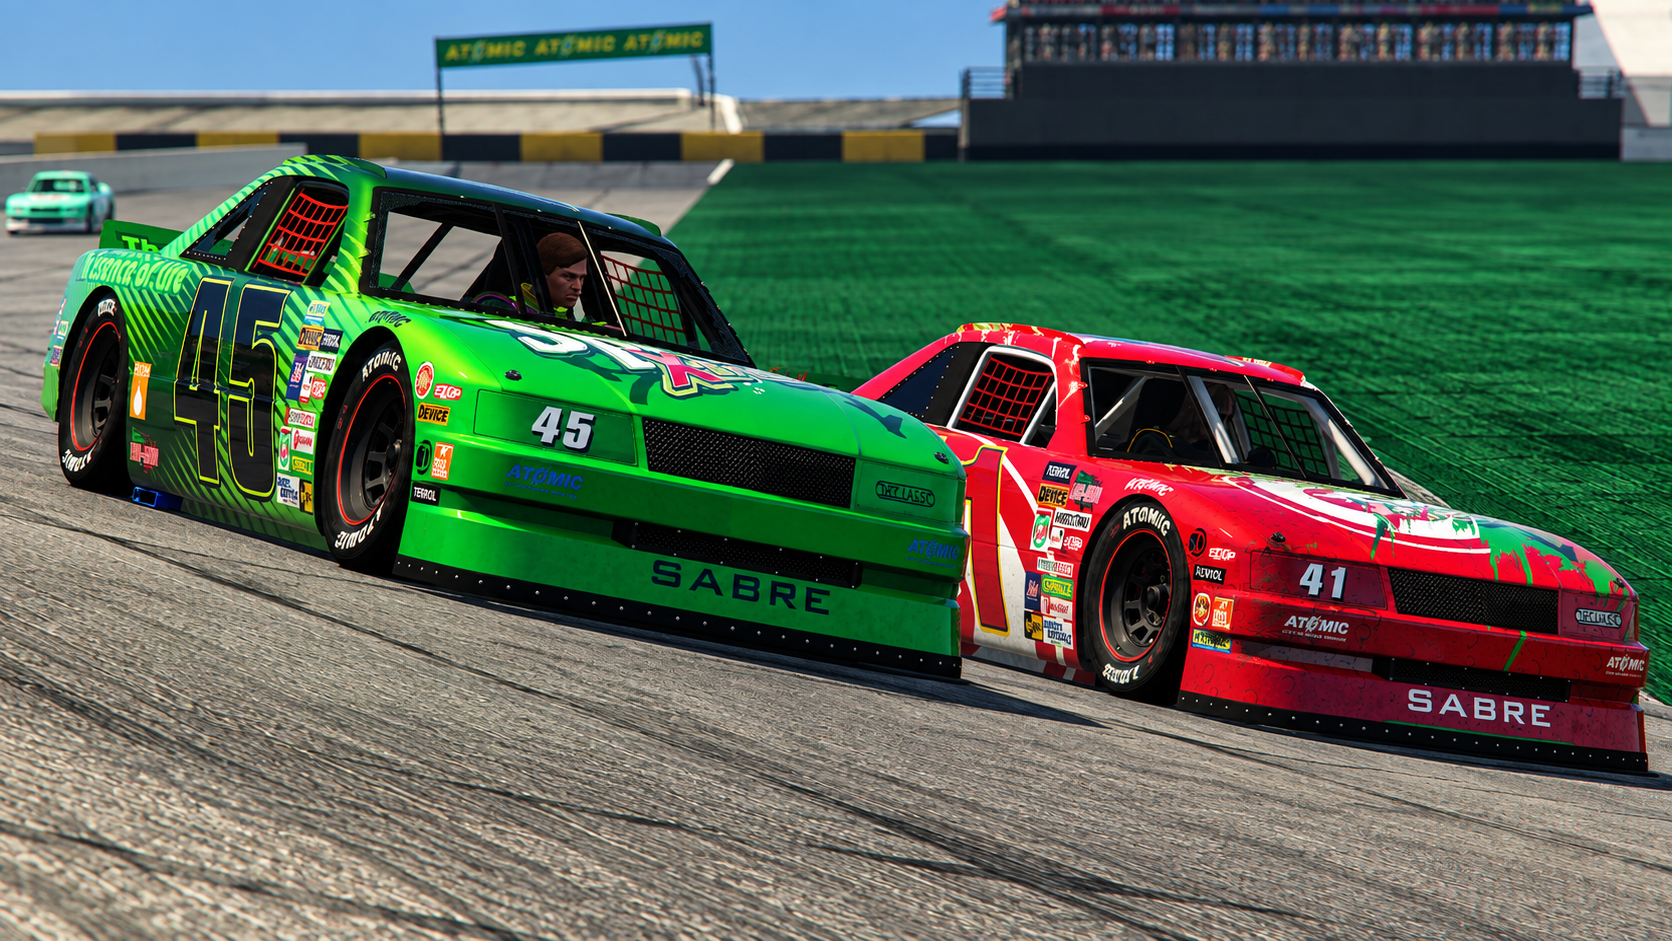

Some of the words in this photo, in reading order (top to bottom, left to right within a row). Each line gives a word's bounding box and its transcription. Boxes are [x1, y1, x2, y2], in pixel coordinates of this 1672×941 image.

[445, 40, 527, 63] ATOMIC
[534, 34, 616, 58] ATOMIC
[623, 30, 704, 54] ATOMIC
[361, 351, 402, 382] ATOMIC
[174, 276, 292, 500] 45
[417, 404, 449, 423] DEVICE
[531, 405, 596, 452] 45
[507, 464, 583, 490] ATOMIC
[906, 538, 960, 560] ATOMIC
[651, 559, 831, 616] SABRE
[1299, 562, 1347, 600] 41
[1284, 615, 1350, 635] ATOMIC
[1407, 688, 1551, 728] SABRE
